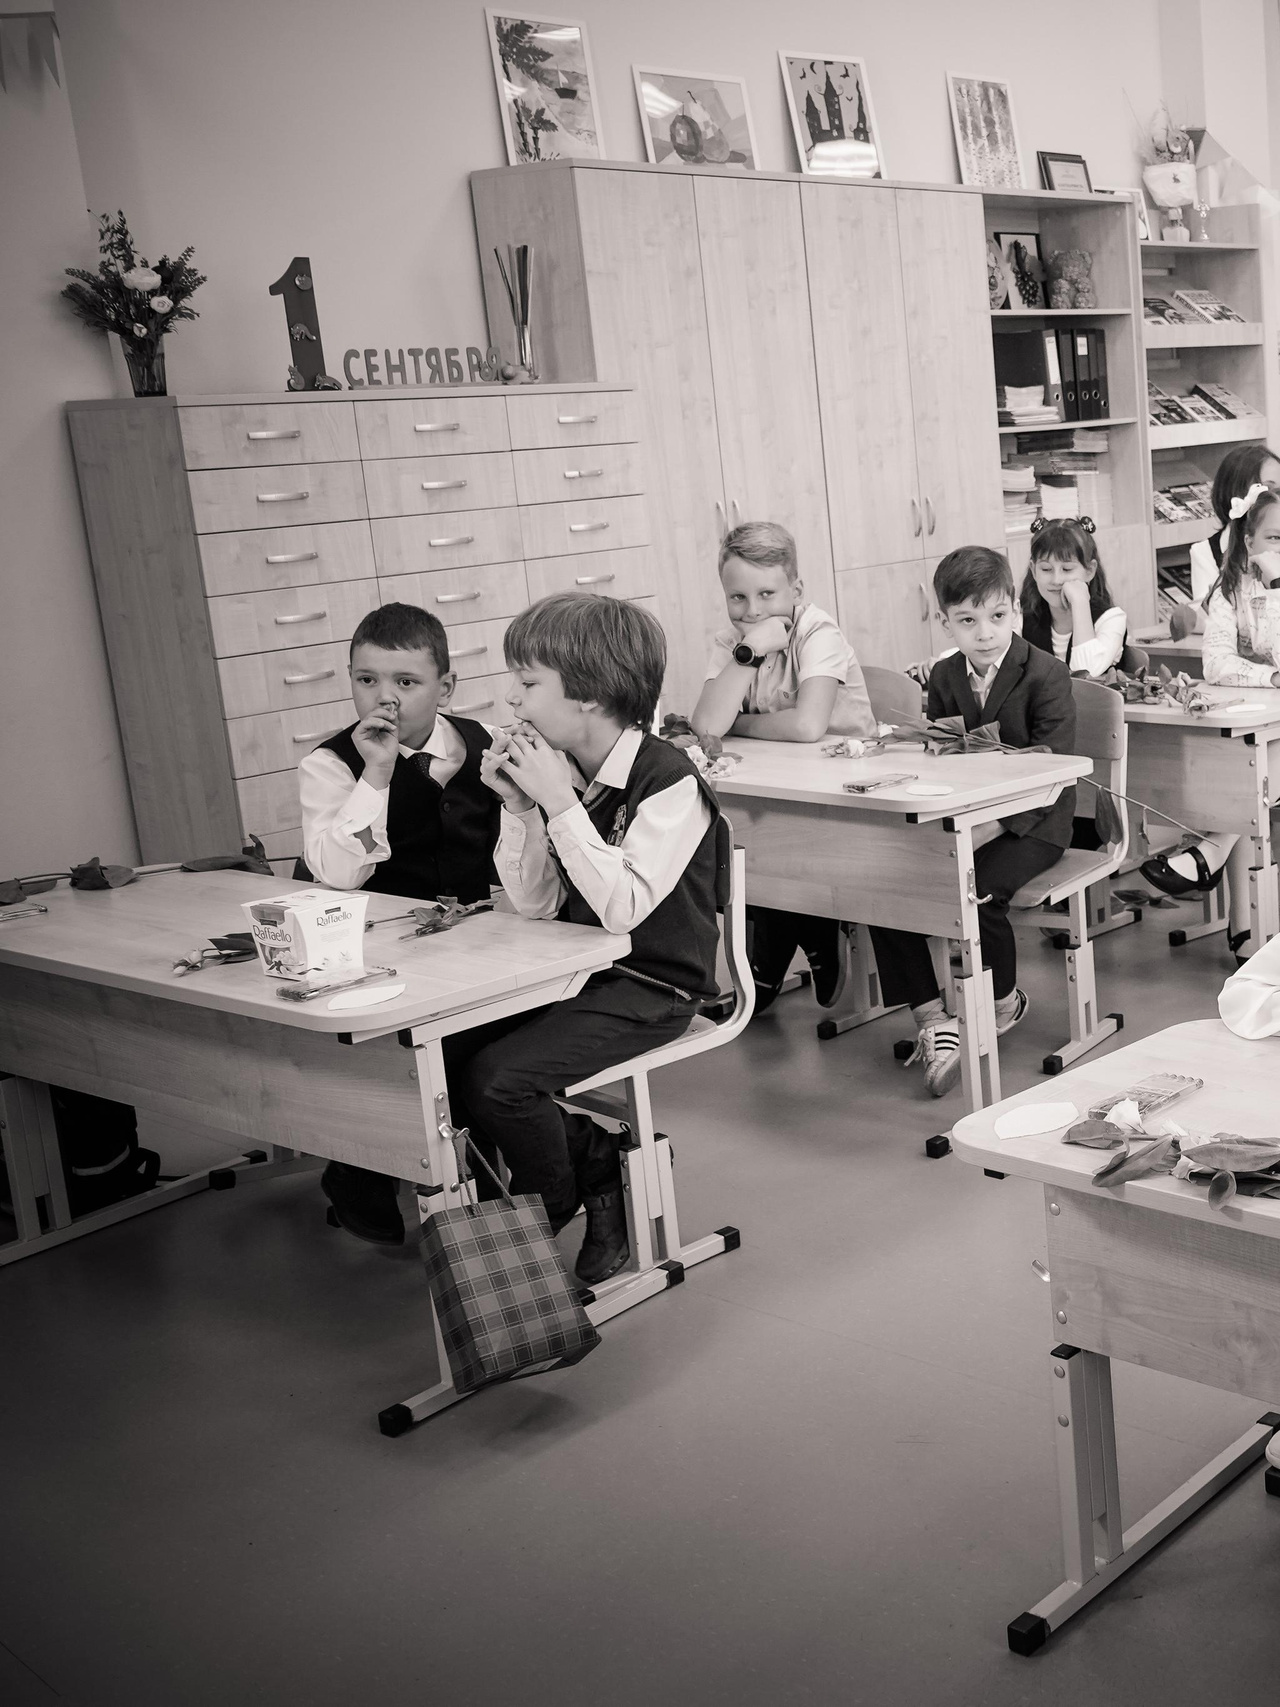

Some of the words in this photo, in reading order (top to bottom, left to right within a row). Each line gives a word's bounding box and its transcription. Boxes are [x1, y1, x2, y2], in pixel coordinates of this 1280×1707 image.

[269, 257, 326, 391] 1
[343, 347, 502, 386] СЕНТЯБРЯ
[316, 911, 353, 927] Raffaello
[253, 925, 292, 943] Raffaello
